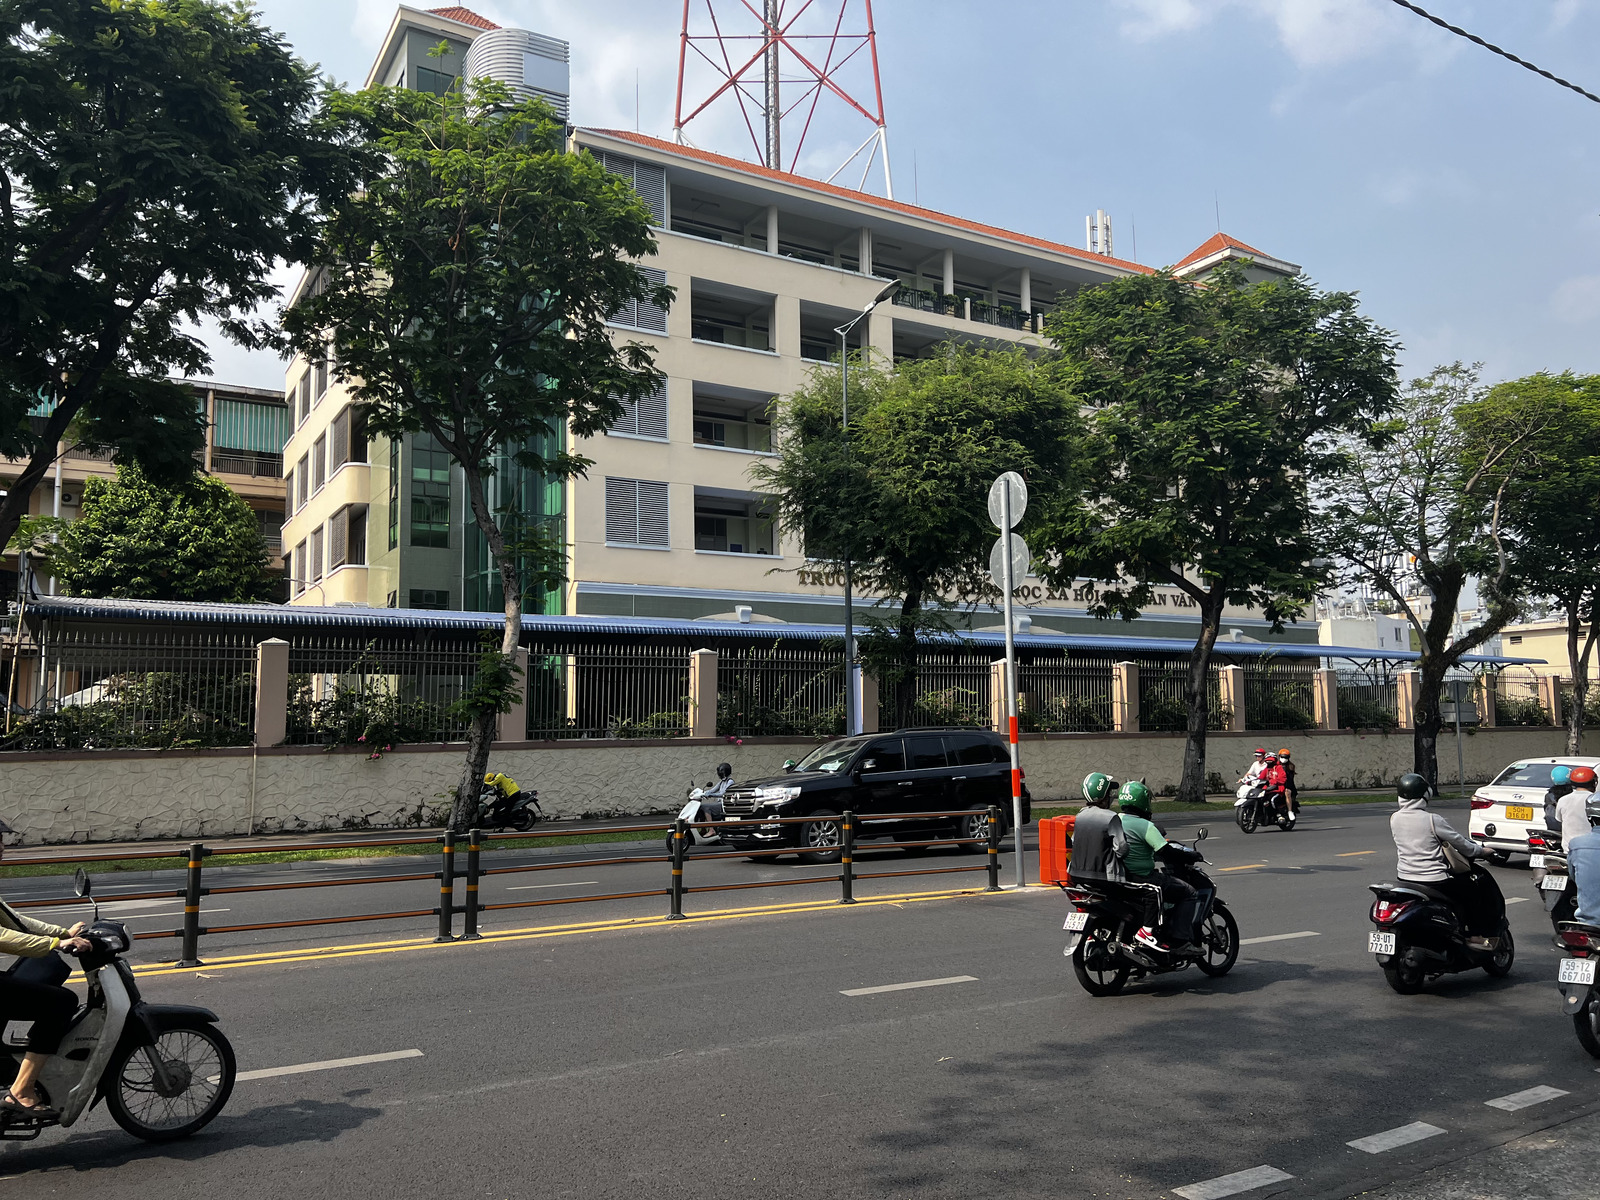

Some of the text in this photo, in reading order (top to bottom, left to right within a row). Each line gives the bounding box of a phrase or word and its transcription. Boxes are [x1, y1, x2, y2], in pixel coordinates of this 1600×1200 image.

[1372, 933, 1391, 944] 59-U1
[1565, 961, 1590, 972] 59-T2
[1561, 971, 1592, 982] 667.08
